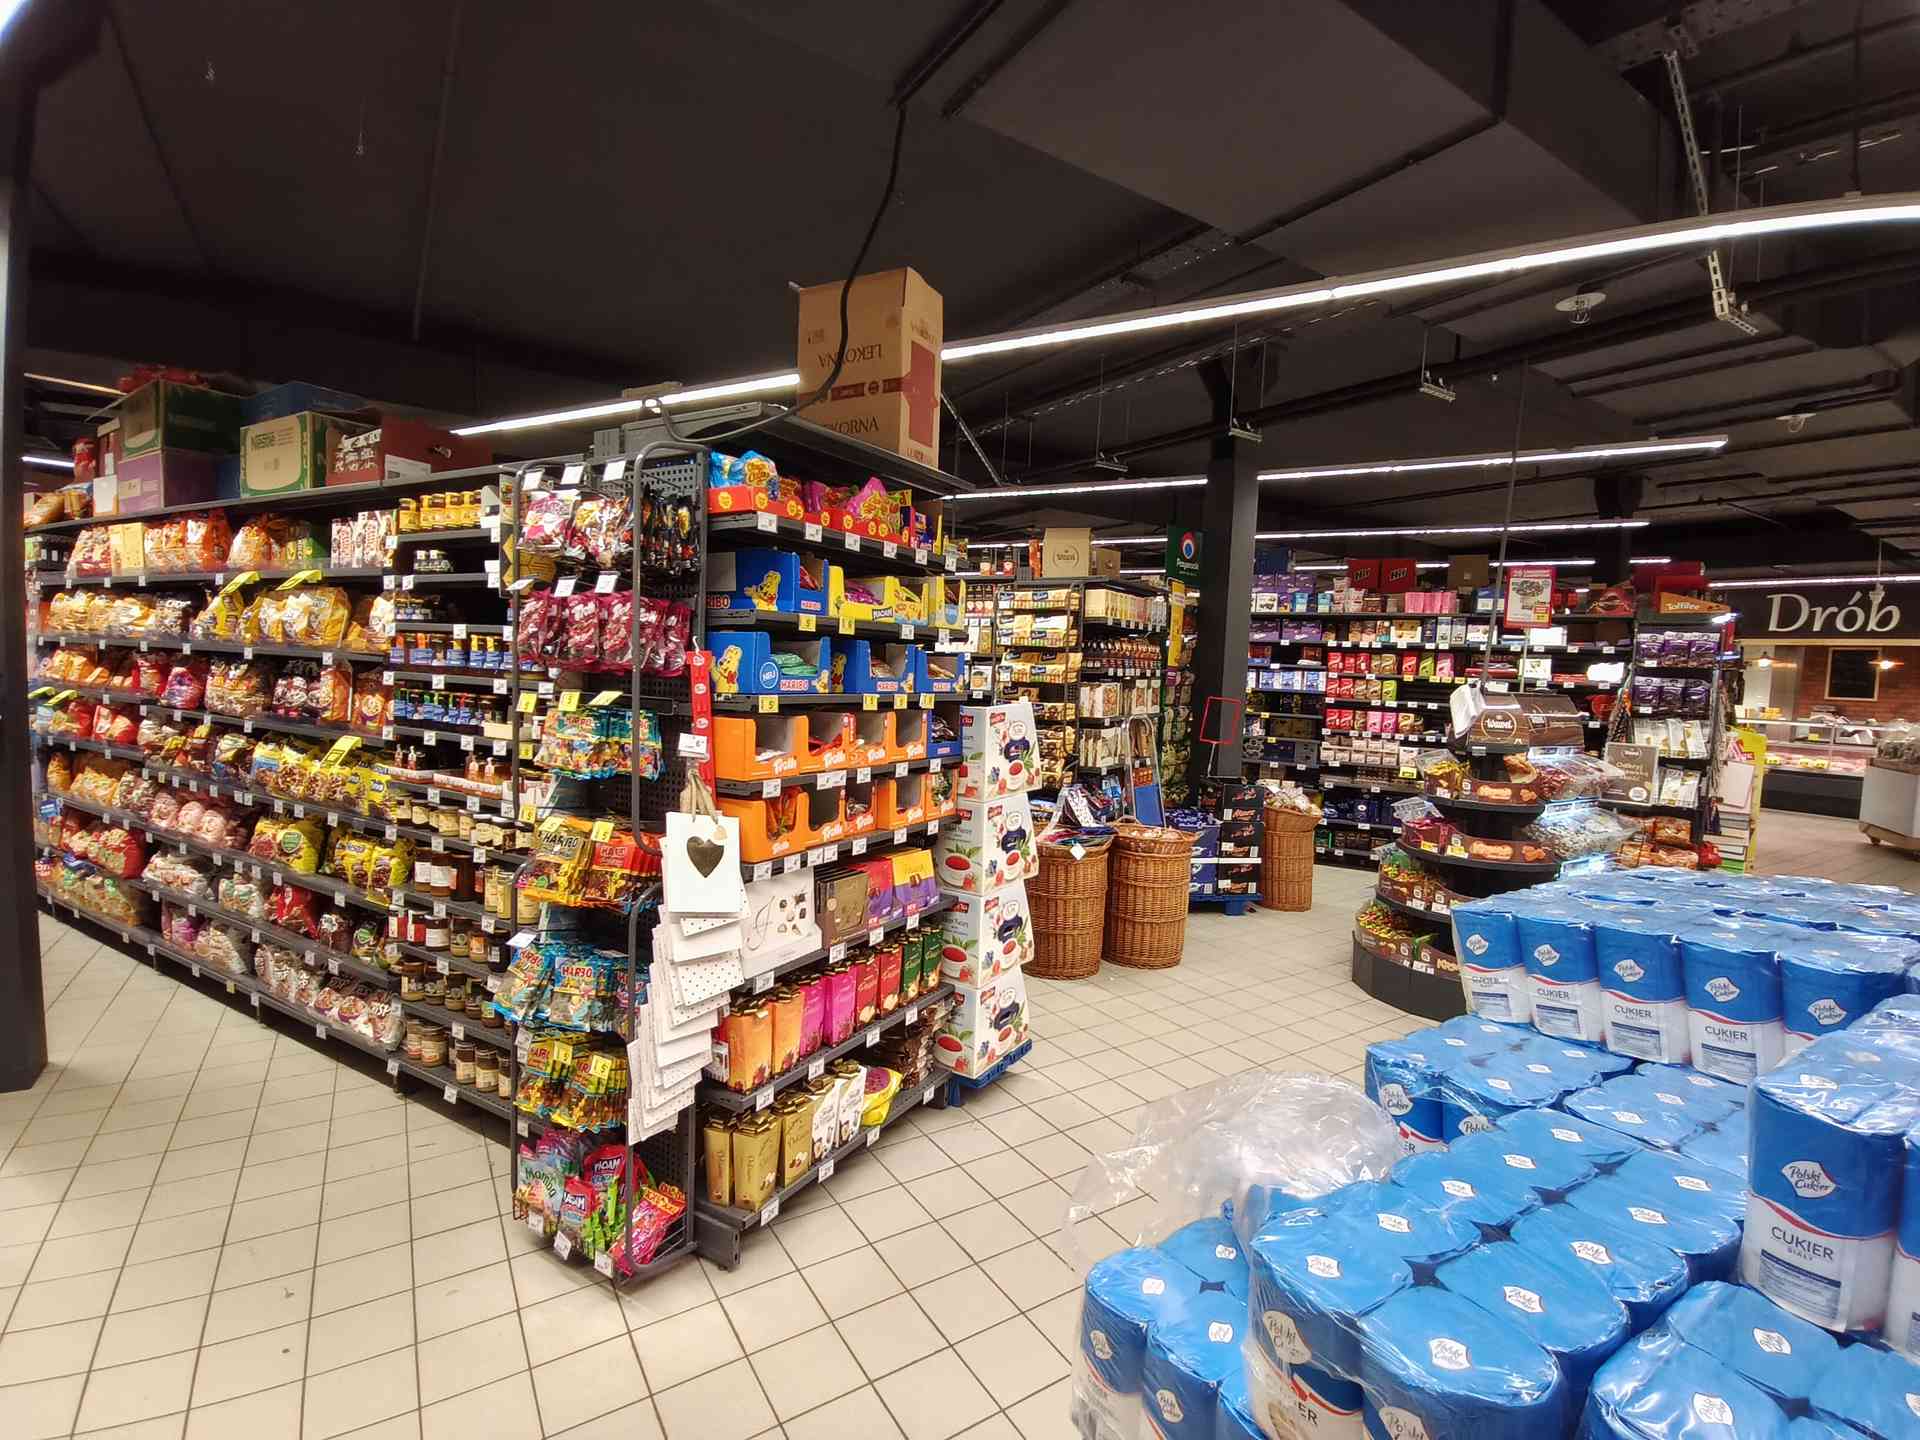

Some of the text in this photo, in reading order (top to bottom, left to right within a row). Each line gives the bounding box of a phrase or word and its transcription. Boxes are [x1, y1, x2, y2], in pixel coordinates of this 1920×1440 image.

[818, 344, 882, 369] LEKONA
[1767, 590, 1901, 632] Drób
[779, 678, 809, 691] HARIBO
[823, 750, 847, 768] Trolli
[543, 831, 578, 848] HARIBO
[560, 965, 592, 978] HARIBO
[1614, 1005, 1652, 1018] CUKIER
[1705, 1025, 1748, 1040] CUKIER
[594, 1155, 623, 1172] MAOAM
[1789, 1166, 1822, 1181] Polski
[1794, 1179, 1830, 1192] Cukier
[1771, 1226, 1834, 1260] CUKIER
